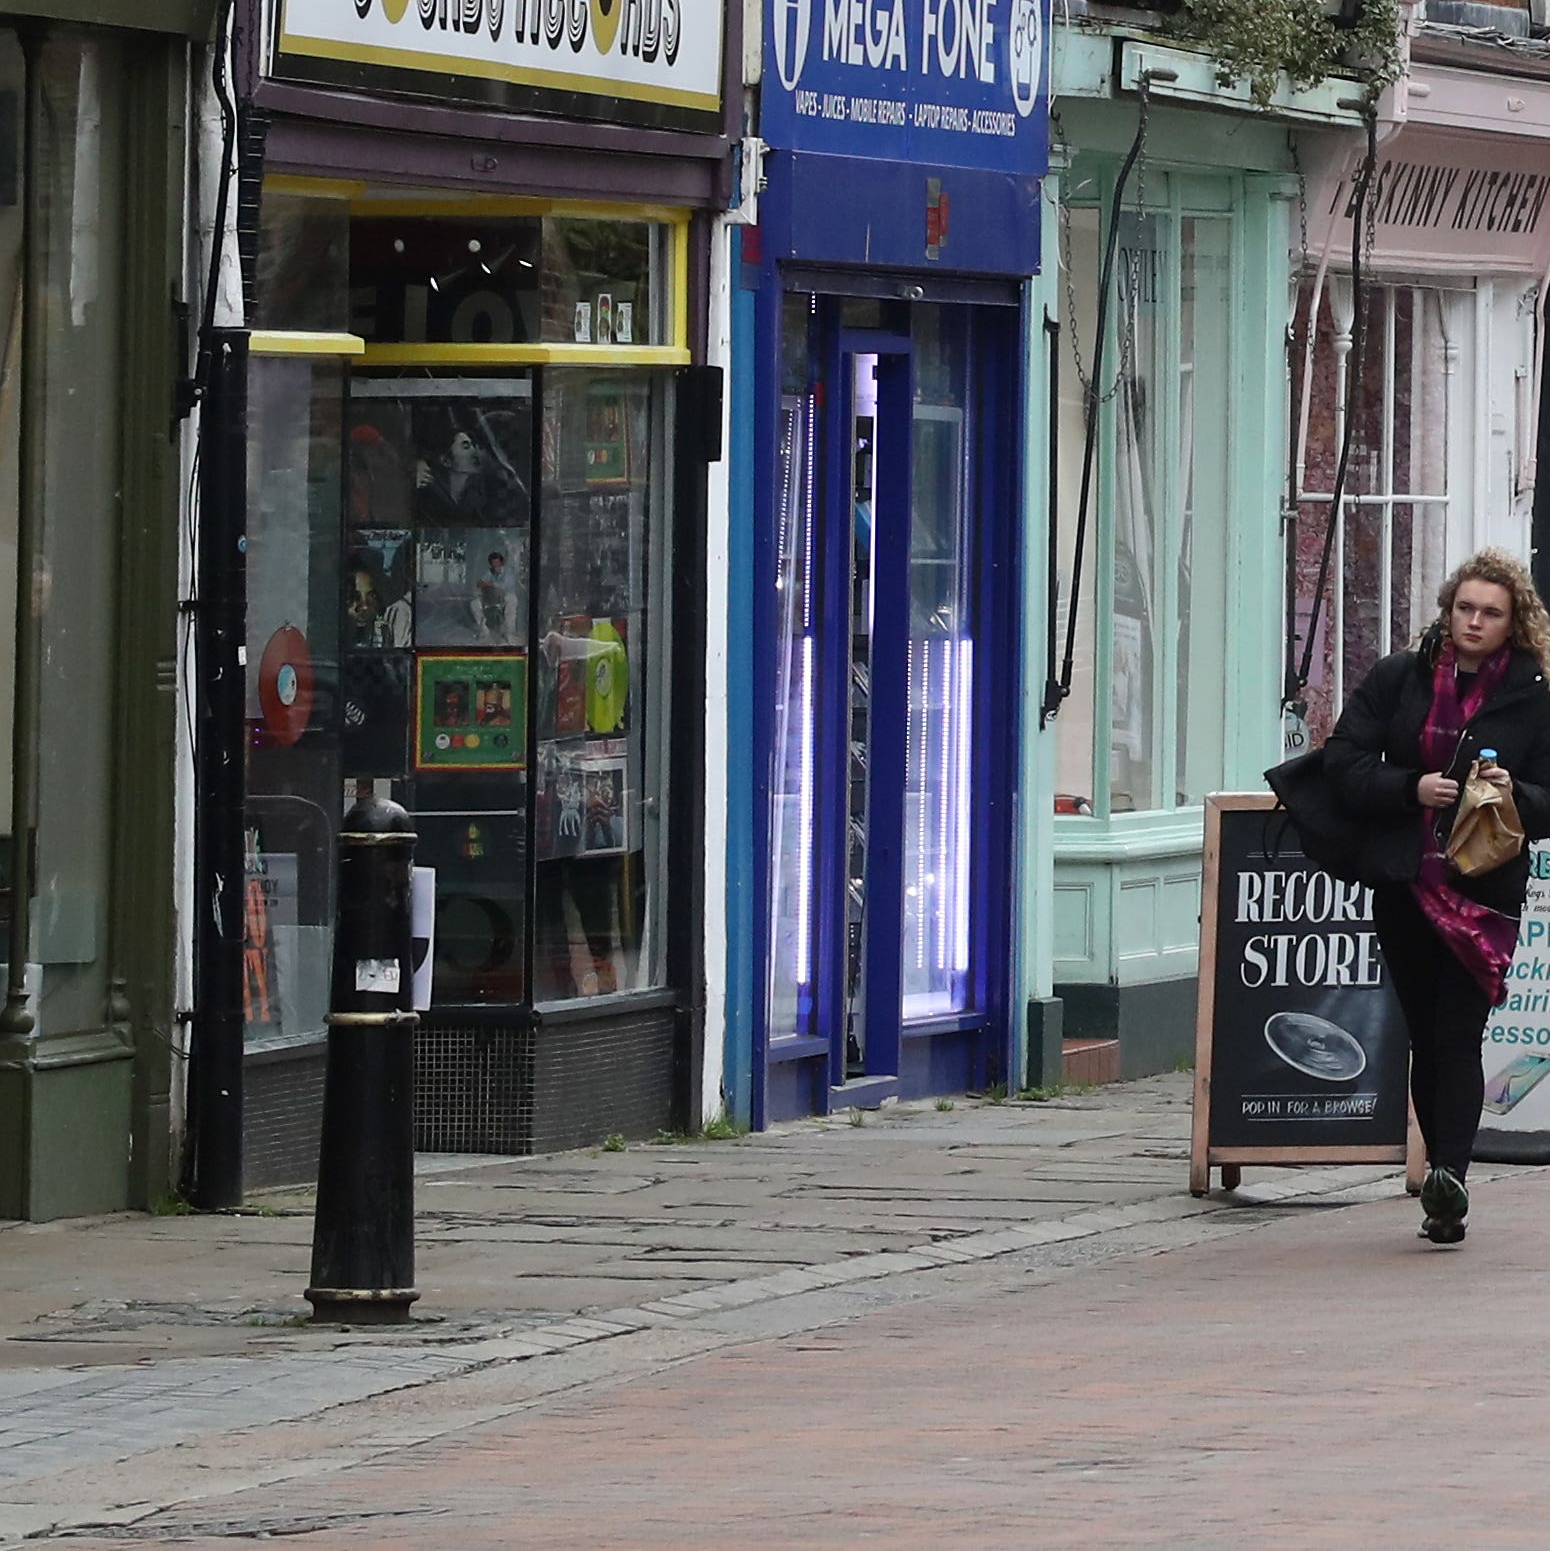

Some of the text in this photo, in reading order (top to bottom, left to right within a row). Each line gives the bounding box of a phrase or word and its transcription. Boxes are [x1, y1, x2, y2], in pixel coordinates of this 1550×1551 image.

[795, 89, 1016, 137] VAPES JUICES MOBILE REPAIRS LAPTOP REPAIRS ACCESSORIES
[1375, 159, 1460, 228] SKINNY
[1234, 870, 1375, 924] RECOR
[1240, 930, 1381, 988] STORE
